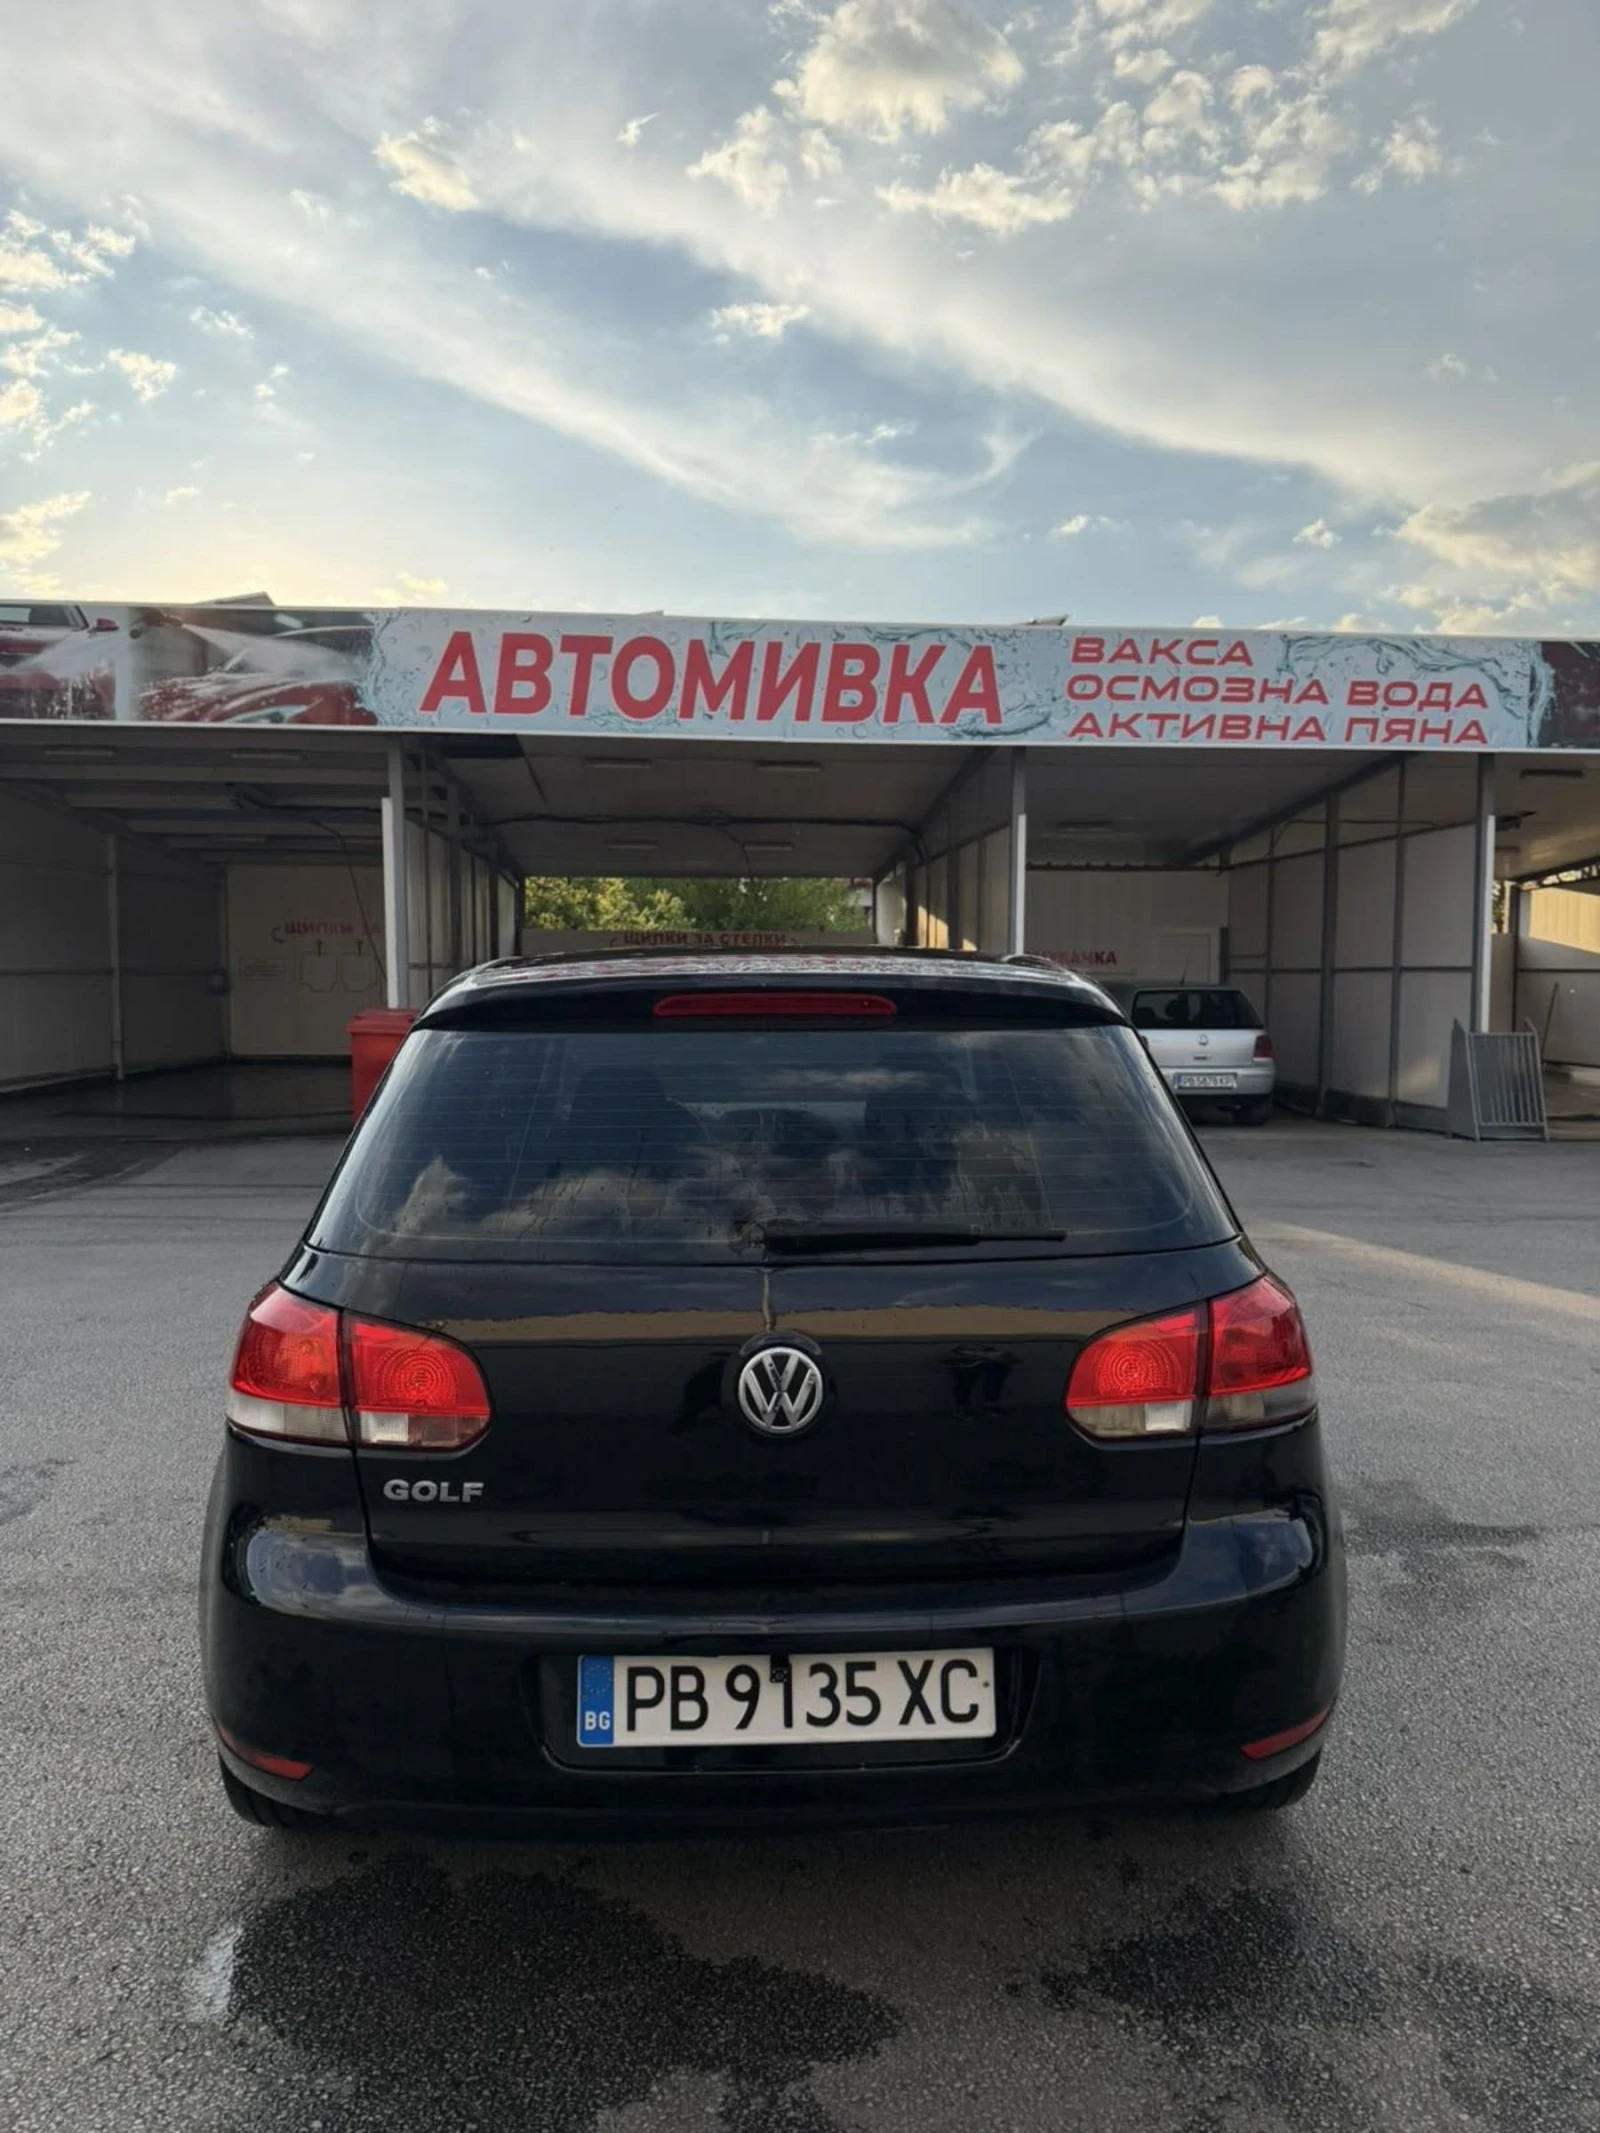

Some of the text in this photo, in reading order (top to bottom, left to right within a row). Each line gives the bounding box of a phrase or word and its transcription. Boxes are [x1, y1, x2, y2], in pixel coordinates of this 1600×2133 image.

[1071, 637, 1254, 667] ВАКСА
[419, 630, 1003, 725] АВТОМИВКА
[1066, 674, 1489, 712] ОСМОЗНА ВОДА
[1067, 712, 1489, 745] АКТИВНА ПЯНА
[383, 1479, 484, 1503] GOLF
[584, 1711, 611, 1731] BG
